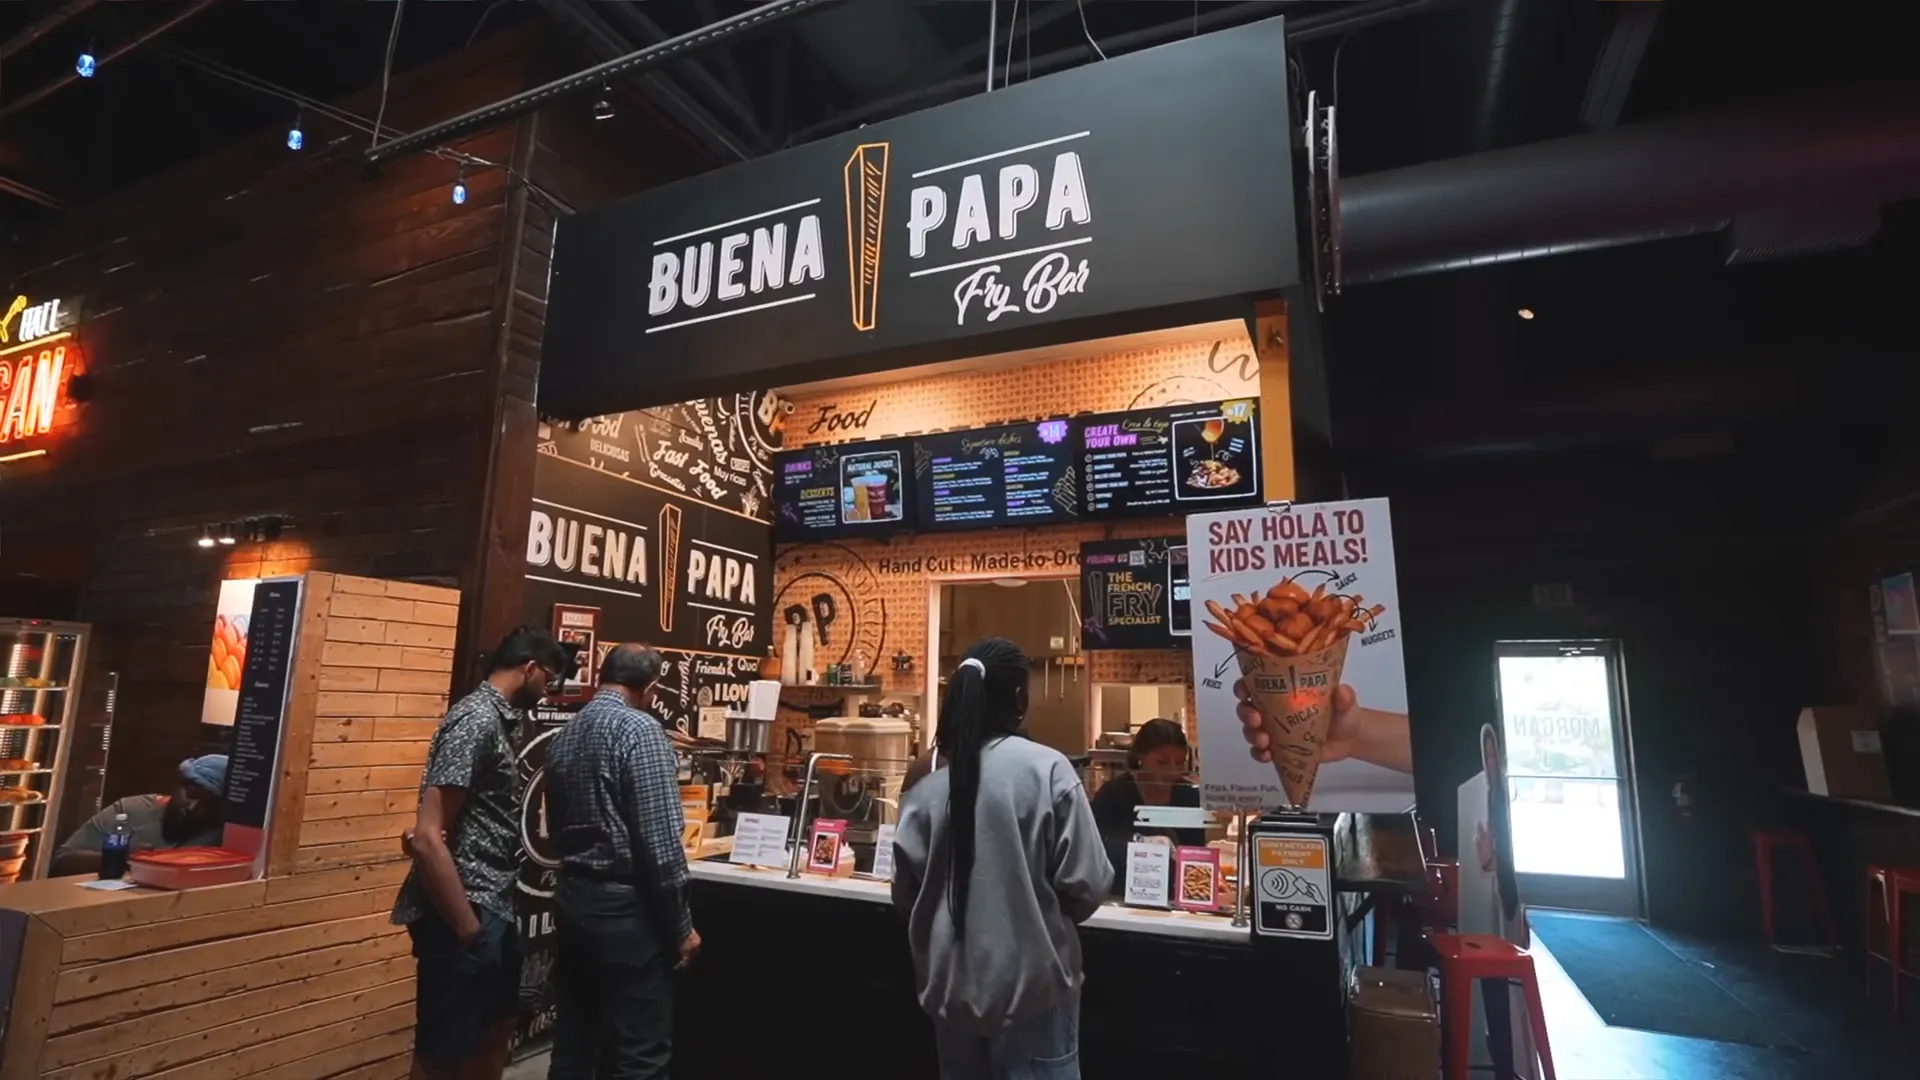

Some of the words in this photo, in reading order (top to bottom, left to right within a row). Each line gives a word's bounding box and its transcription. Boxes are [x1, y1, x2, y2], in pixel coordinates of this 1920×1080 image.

[906, 151, 1091, 258] PAPA
[648, 214, 825, 316] BUENA
[953, 265, 1020, 325] Fry
[1023, 252, 1091, 315] Bar
[808, 400, 877, 433] Food
[1084, 424, 1119, 438] CREATE
[1085, 436, 1110, 448] YOUR
[1112, 433, 1138, 446] OWN
[653, 439, 689, 468] Fast
[688, 458, 728, 500] Food
[1207, 519, 1252, 546] SAY
[1261, 511, 1329, 541] HOLA
[1332, 509, 1364, 535] TO
[526, 509, 648, 587] BUENA
[1209, 545, 1266, 573] KIDS
[1273, 537, 1369, 569] MEALS!
[878, 557, 922, 574] Hand
[926, 556, 957, 572] Cut
[1086, 553, 1117, 564] FOLLOW
[687, 548, 756, 607] PAPA
[1107, 571, 1133, 583] THE
[1335, 572, 1358, 591] SAUCE
[1107, 582, 1152, 593] FRENCH
[1107, 583, 1163, 617] FRY
[1107, 615, 1162, 626] SPECIALIST
[706, 614, 732, 648] Fry
[731, 616, 755, 648] Bar
[1360, 628, 1396, 648] NUGGETS
[695, 659, 726, 676] Friends
[1201, 677, 1223, 690] FRIES
[1300, 673, 1328, 689] PAPA
[1286, 703, 1320, 727] RICAS
[1260, 841, 1322, 850] CONTACTLESS
[1271, 850, 1313, 858] PAYMENT
[1281, 858, 1305, 866] ONLY
[1289, 904, 1312, 913] CASH
